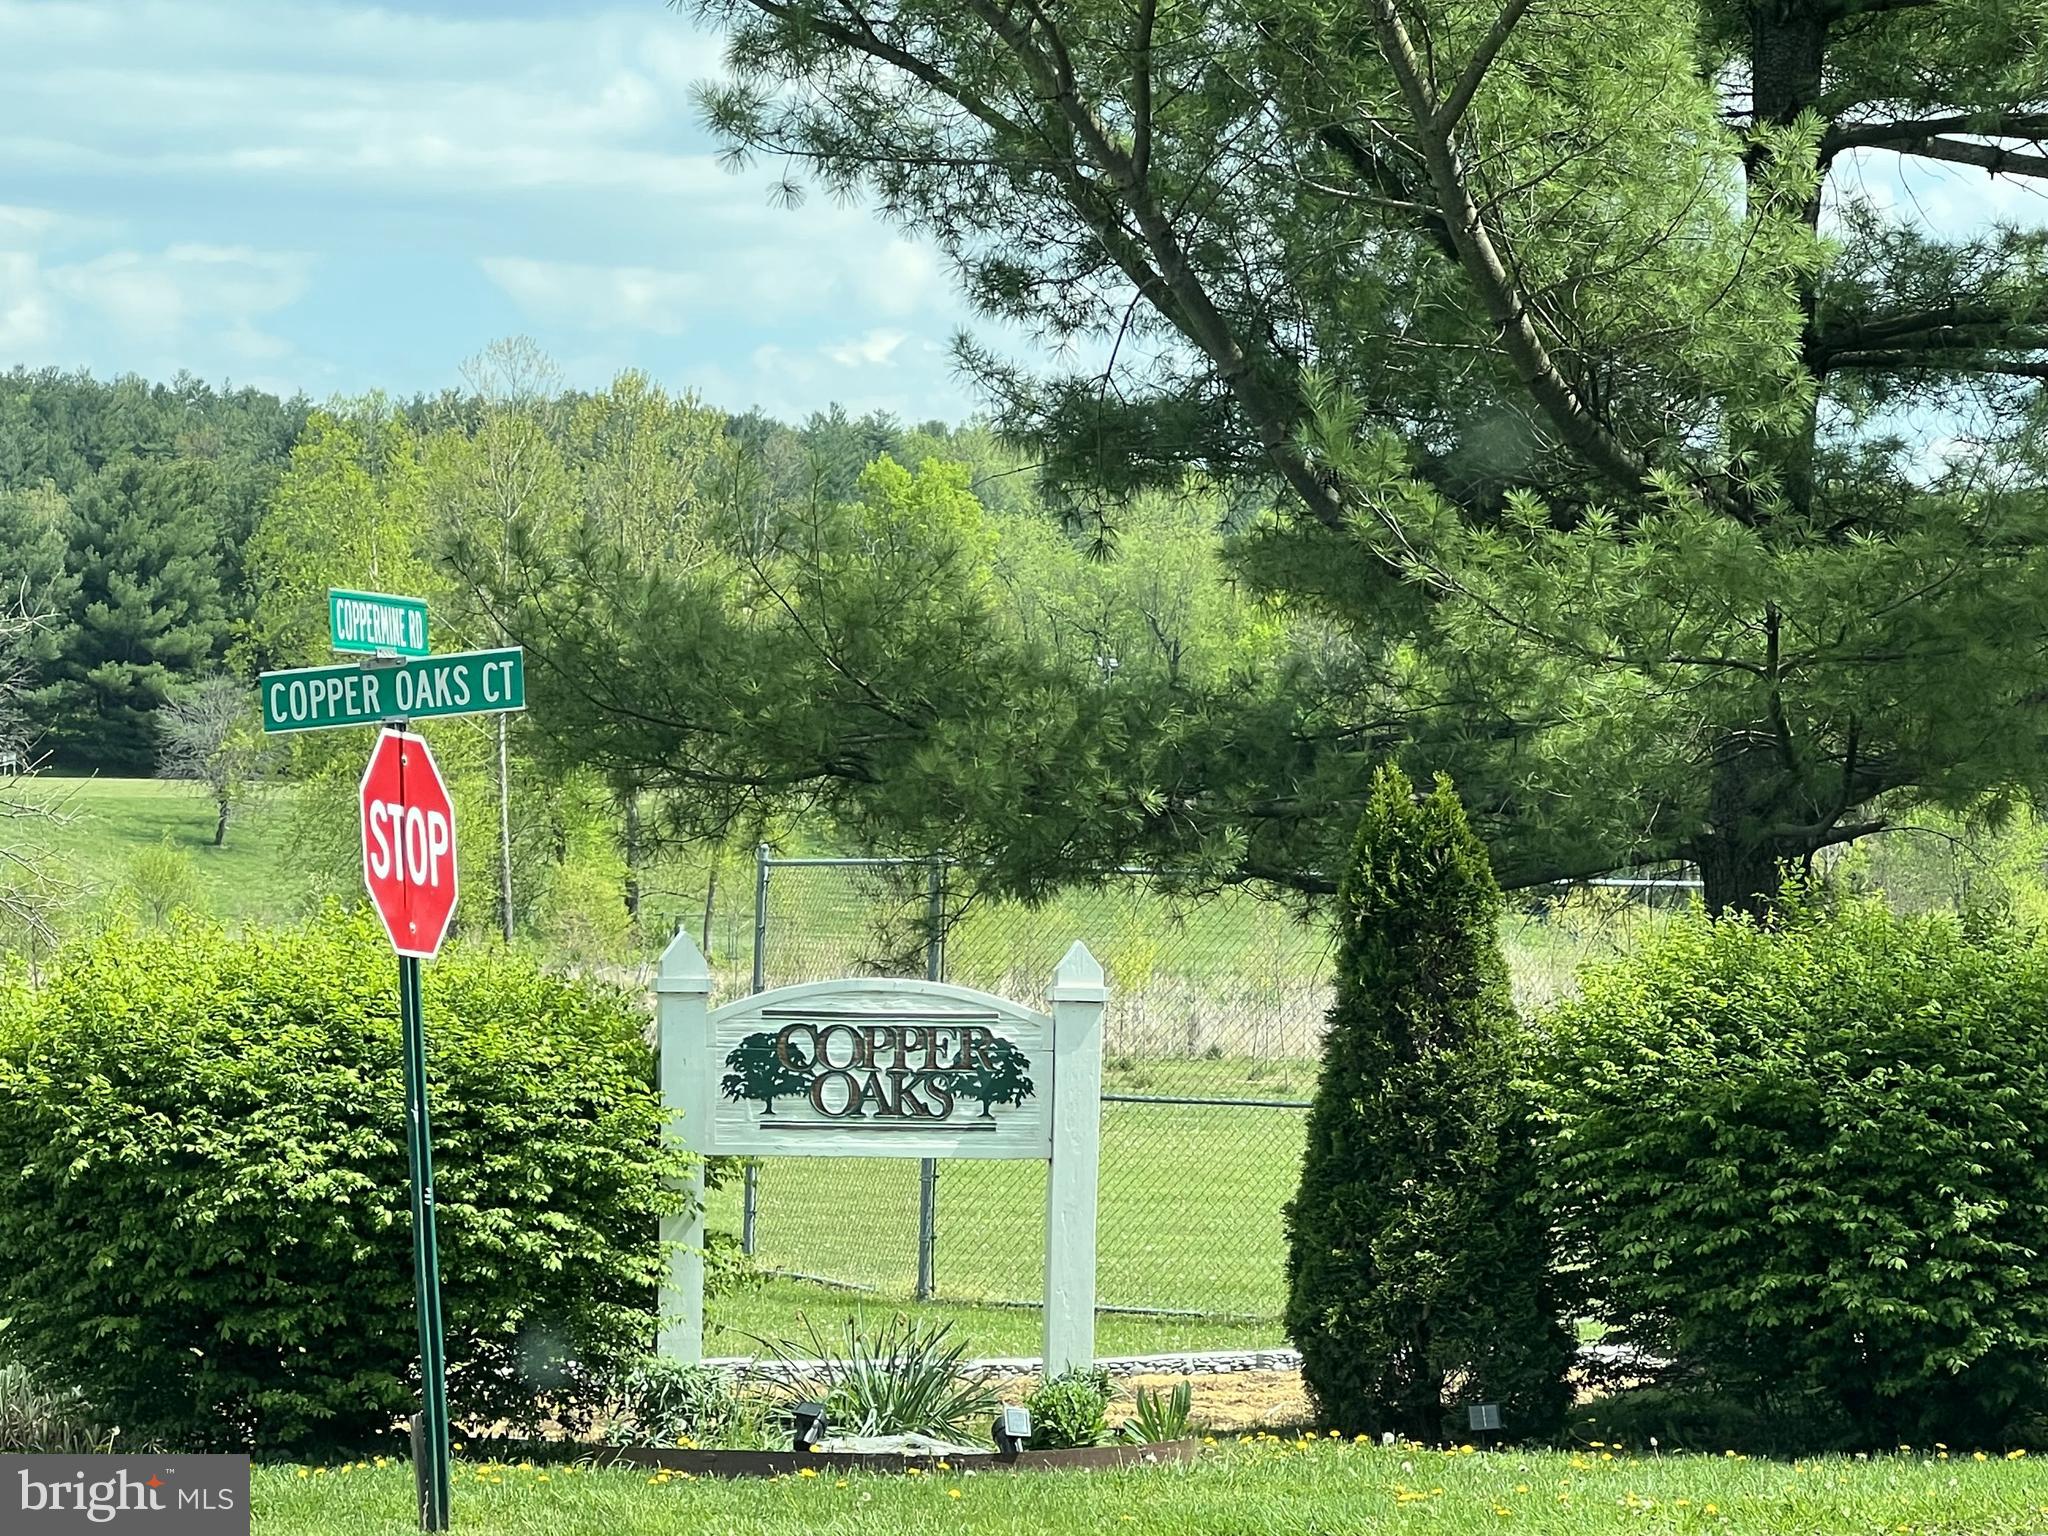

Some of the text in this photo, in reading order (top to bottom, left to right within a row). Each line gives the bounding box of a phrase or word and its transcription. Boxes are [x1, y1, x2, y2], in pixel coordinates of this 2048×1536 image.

[336, 598, 423, 649] COPPERMINE RD
[270, 660, 514, 724] COPPER OAKS CT
[369, 799, 448, 887] STOP
[776, 1022, 996, 1072] COPPER
[809, 1069, 955, 1121] OAKS
